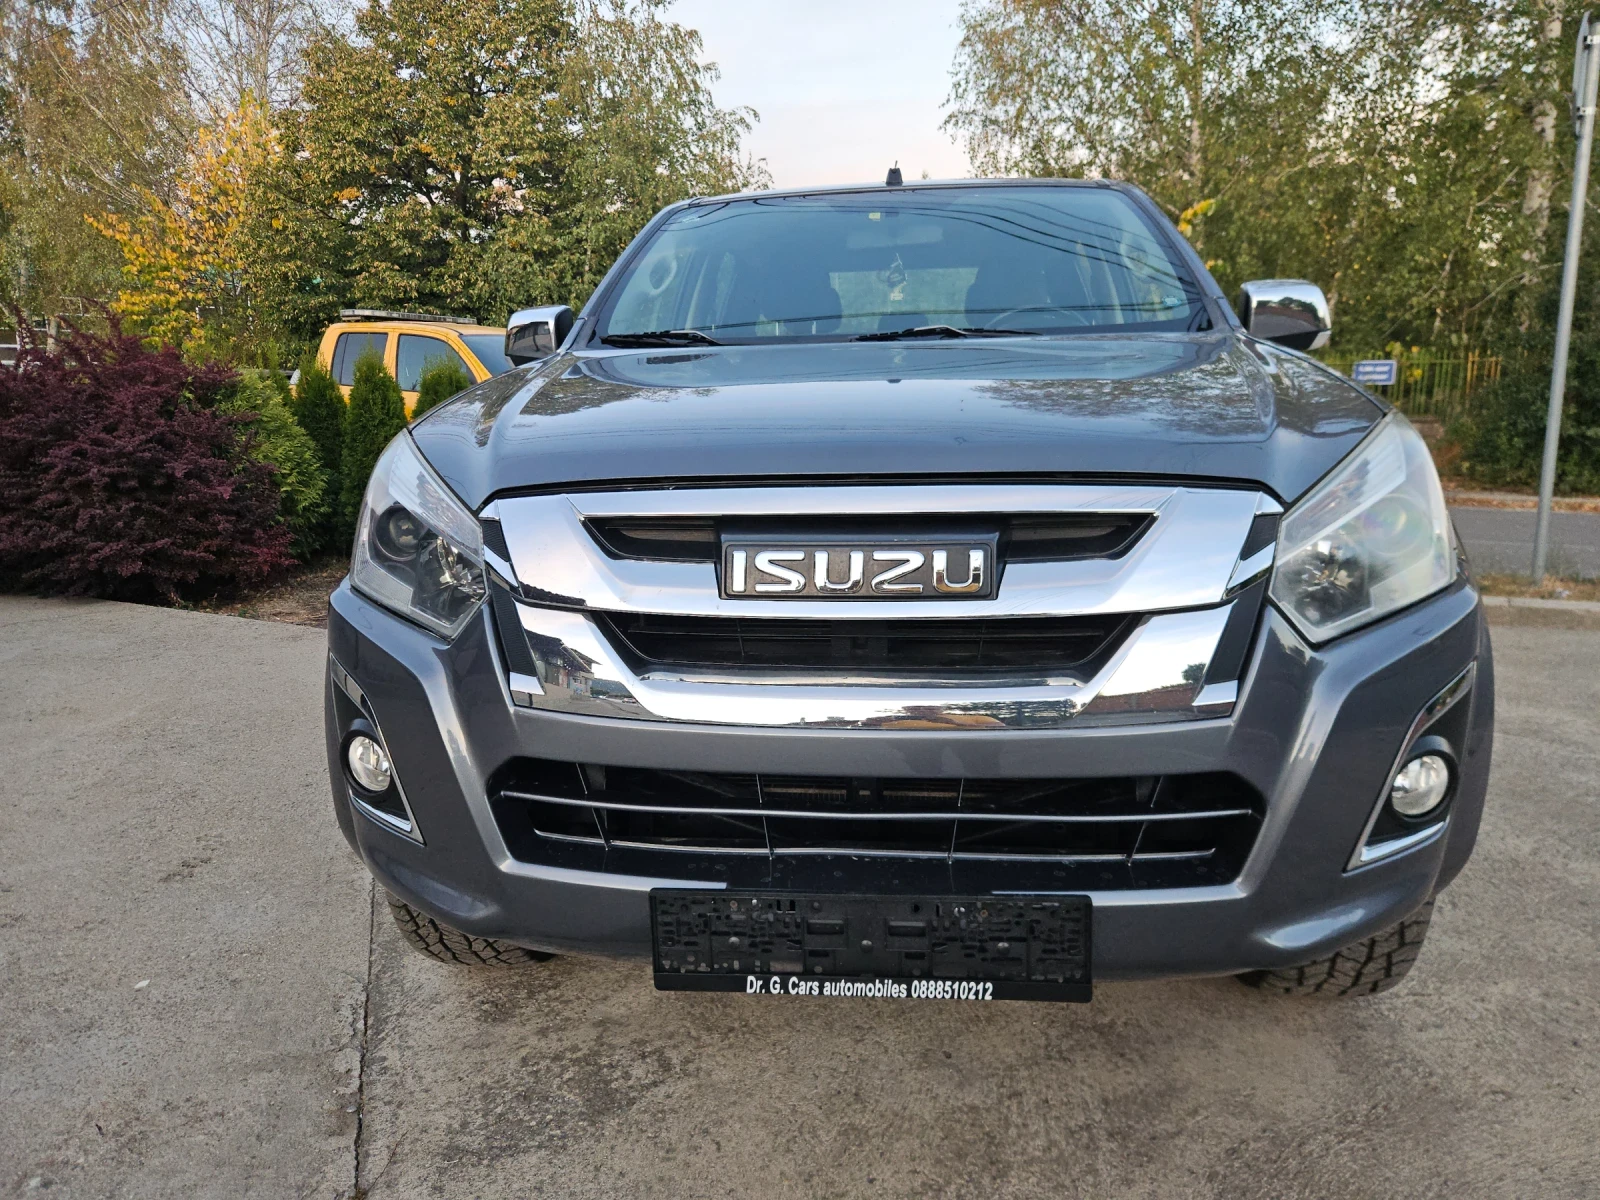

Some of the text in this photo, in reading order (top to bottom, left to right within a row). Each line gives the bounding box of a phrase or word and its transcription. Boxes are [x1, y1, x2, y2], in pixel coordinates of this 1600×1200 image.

[732, 550, 984, 593] ISUZU
[746, 975, 993, 1000] Dr. G. Cars automobiles 0888510212
